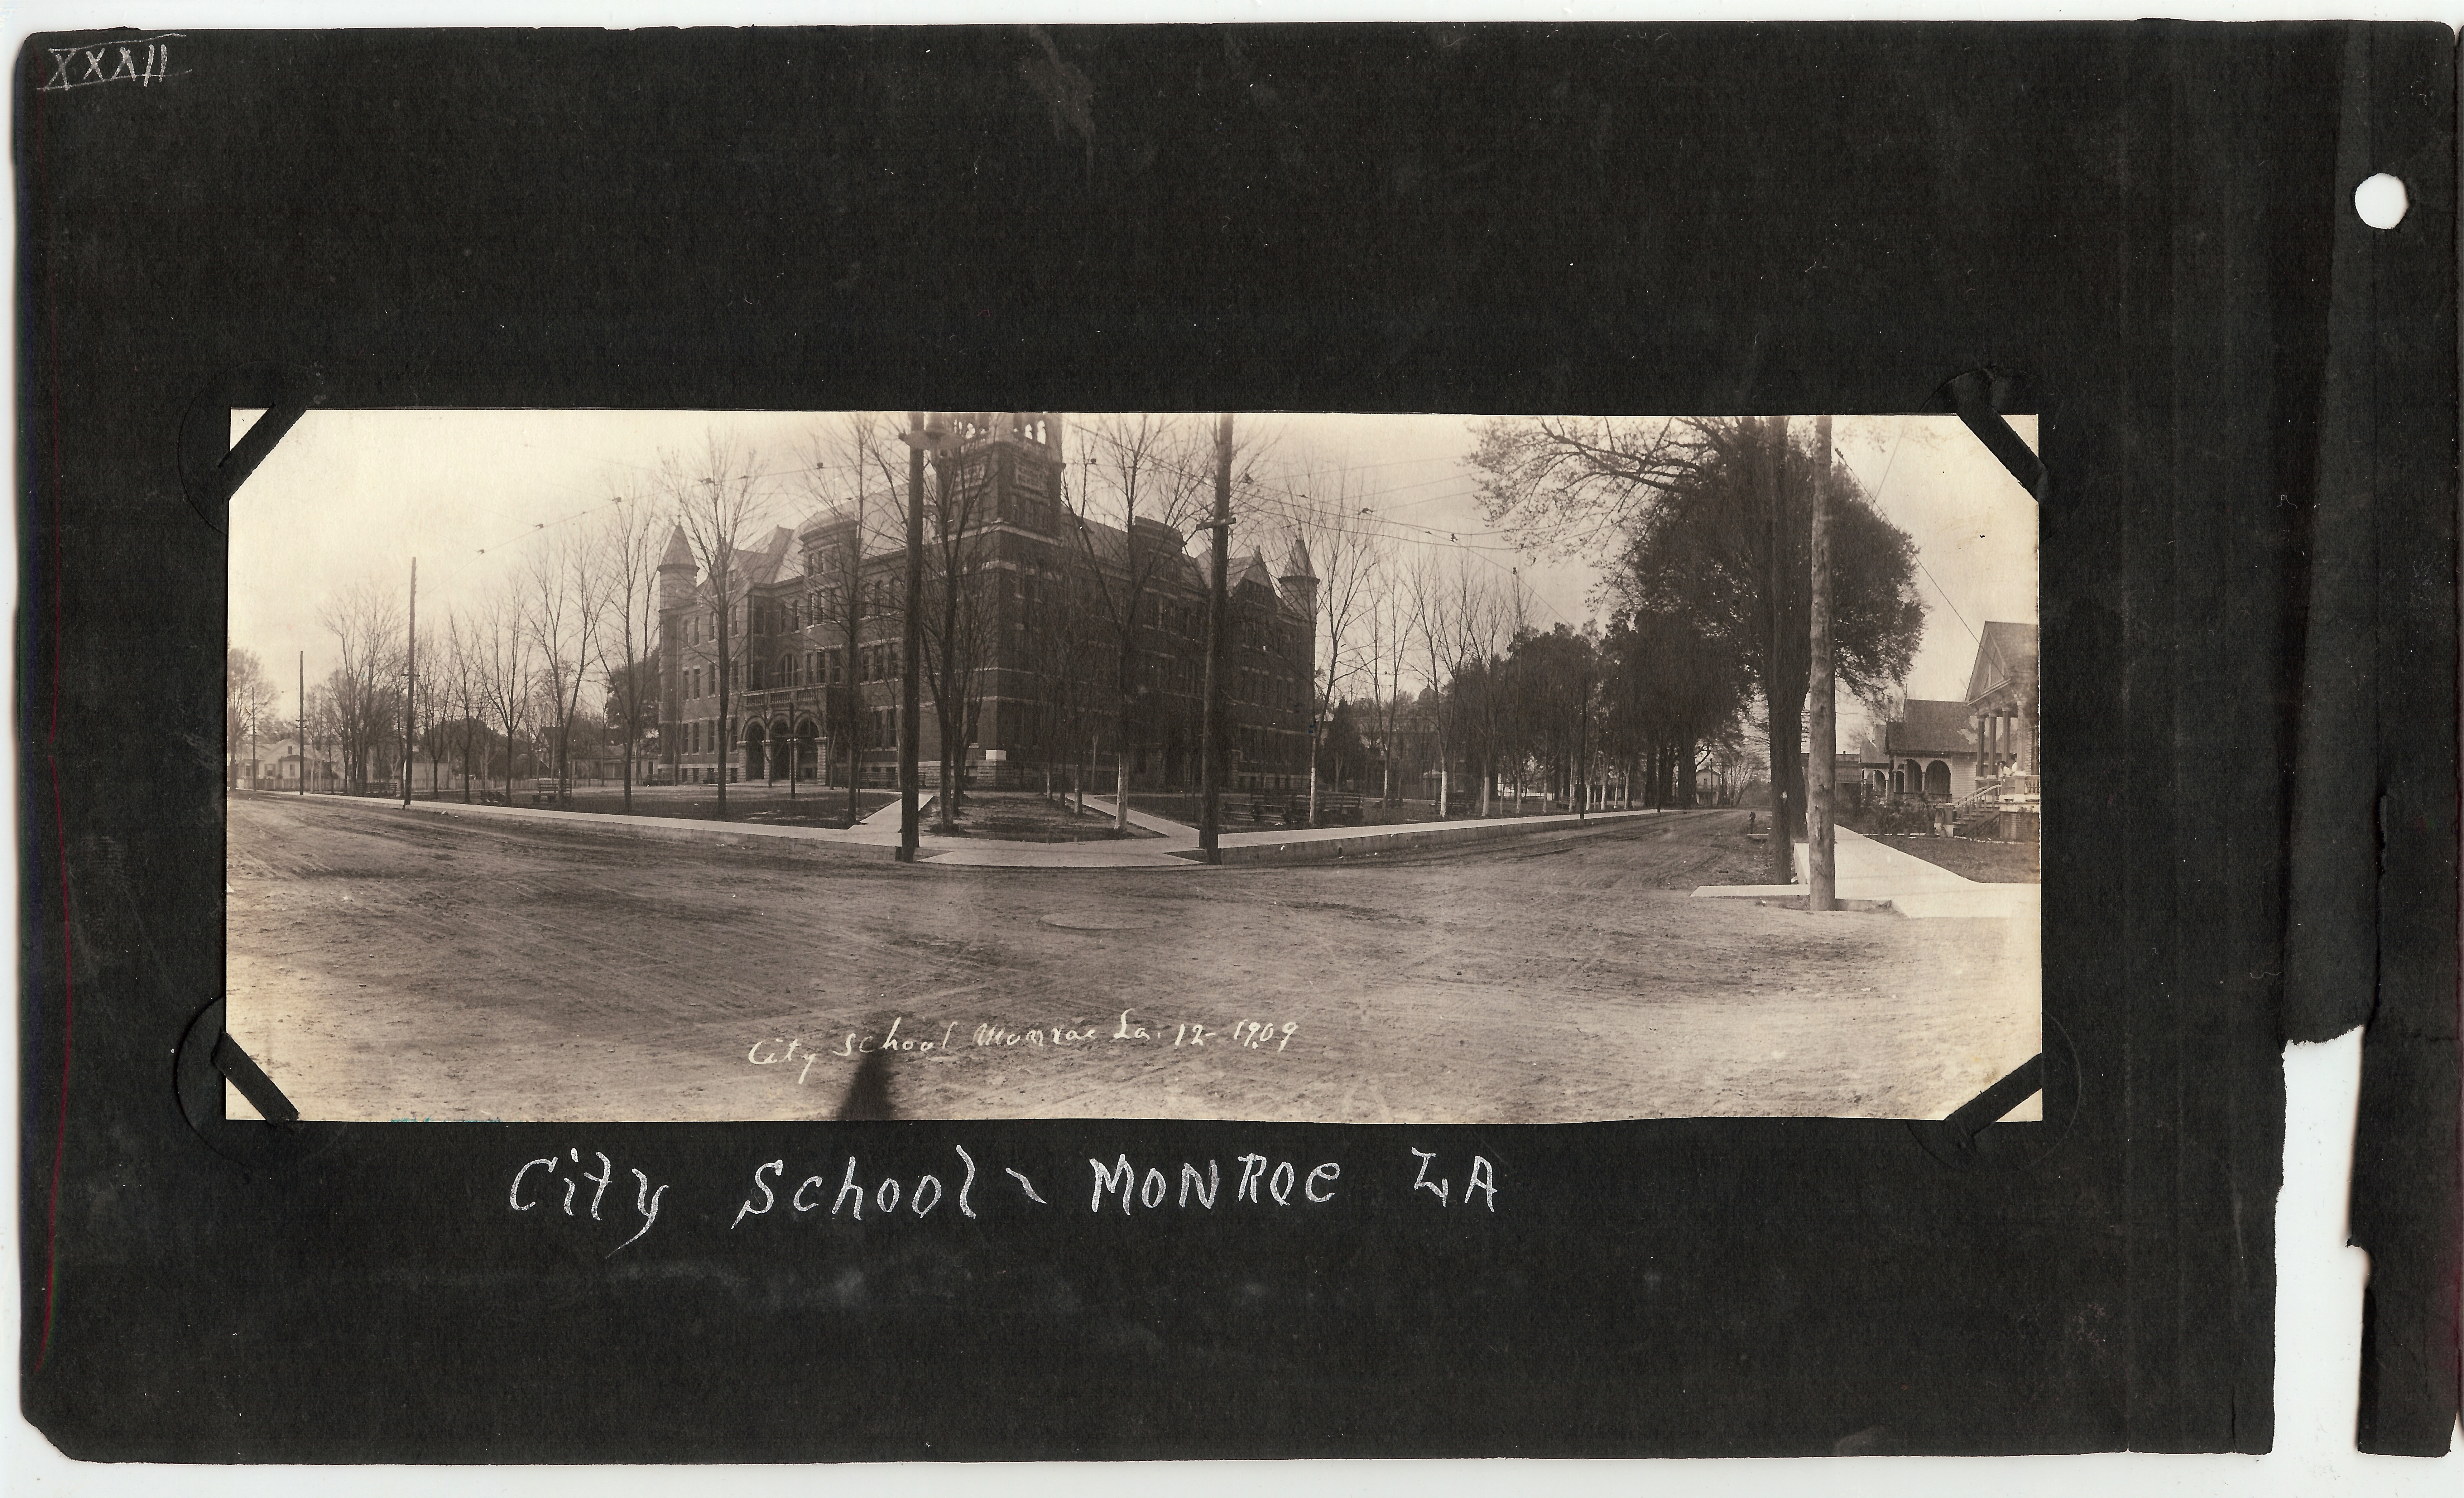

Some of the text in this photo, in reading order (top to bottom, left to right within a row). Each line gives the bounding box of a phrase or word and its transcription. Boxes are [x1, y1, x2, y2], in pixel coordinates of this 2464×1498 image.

[43, 43, 169, 92] XXXII
[748, 1038, 816, 1084] City
[509, 1147, 669, 1259] City
[731, 1144, 976, 1230] School
[1411, 1146, 1498, 1213] LA
